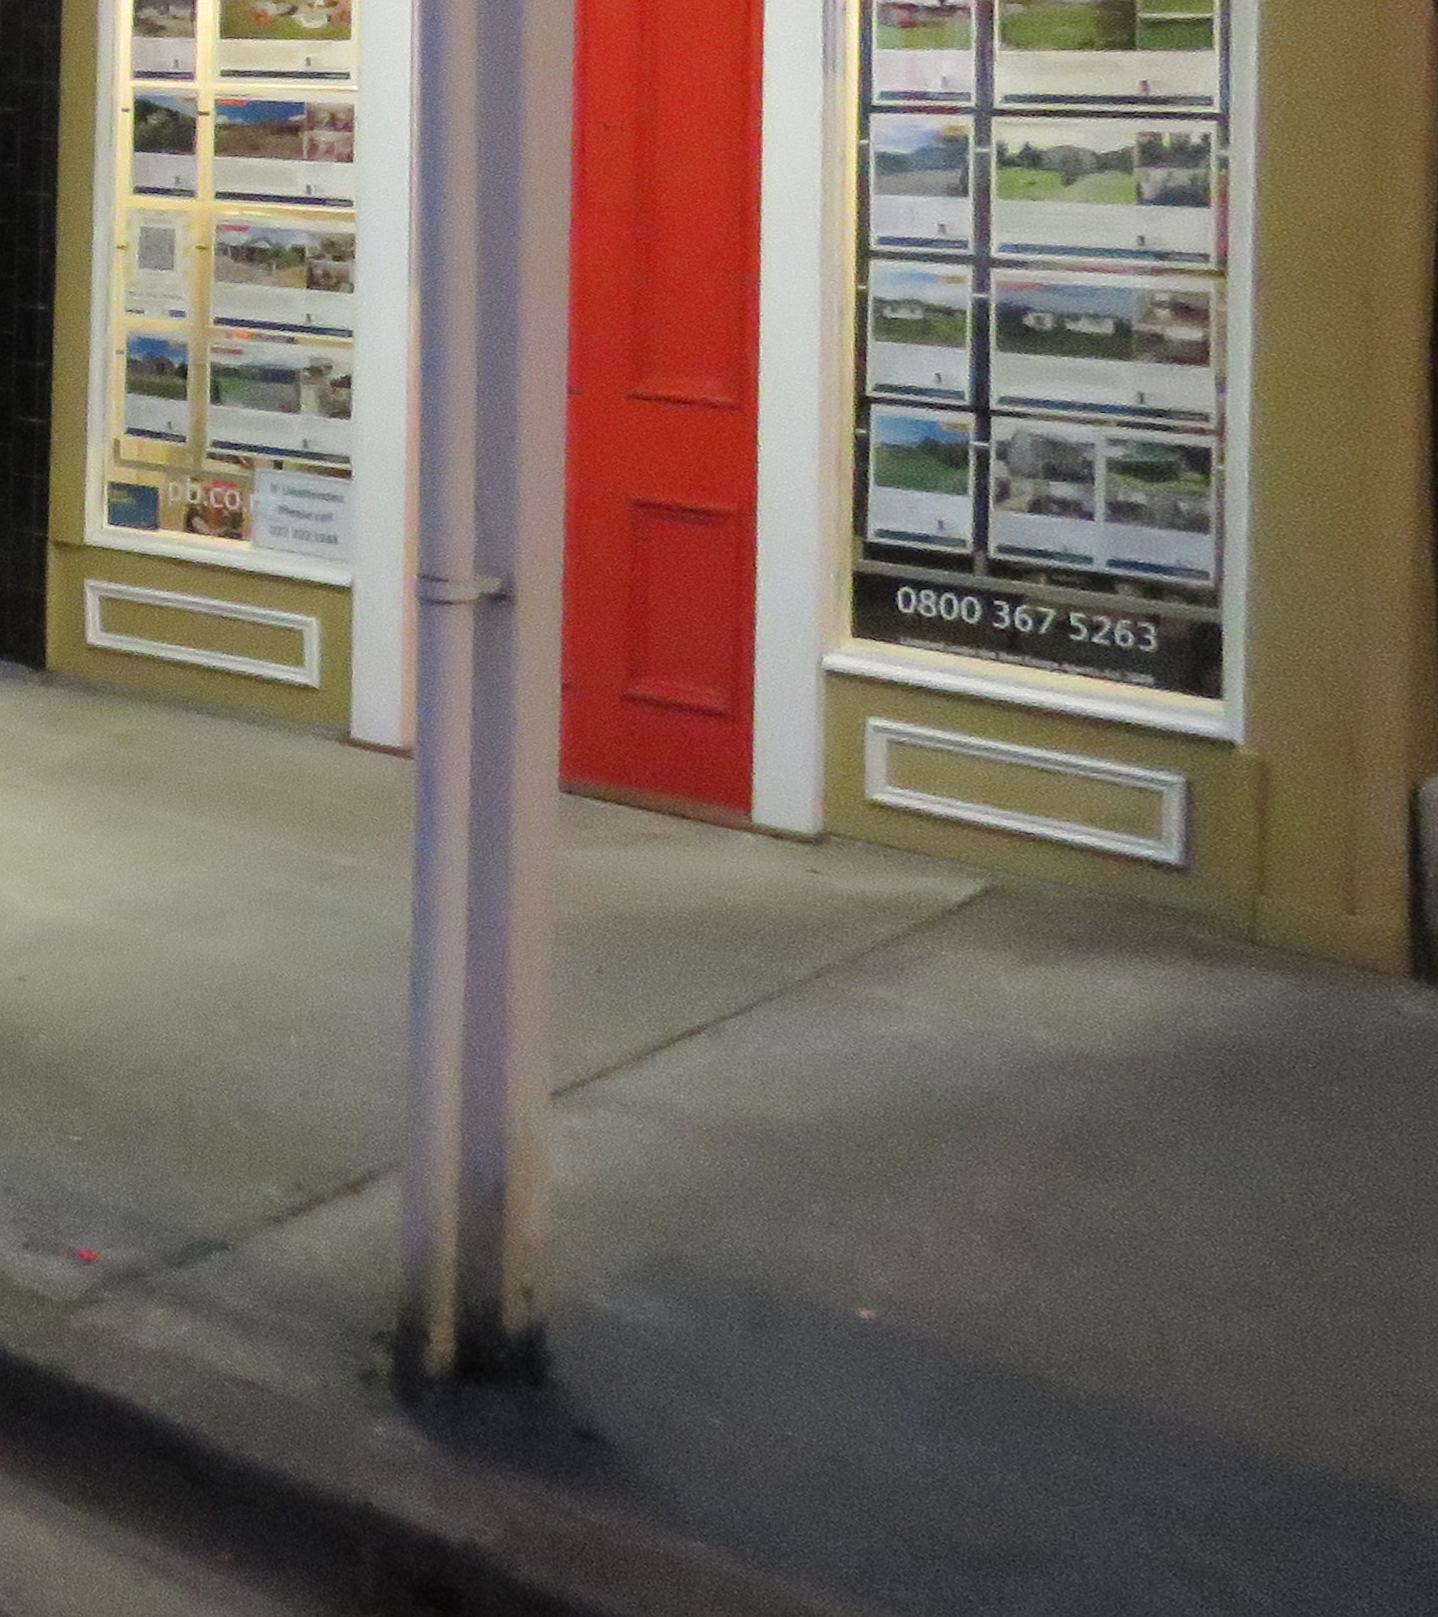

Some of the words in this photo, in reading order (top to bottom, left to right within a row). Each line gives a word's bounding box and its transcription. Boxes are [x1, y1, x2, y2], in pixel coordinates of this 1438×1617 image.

[895, 585, 982, 625] 0800
[992, 599, 1057, 636] 367
[1068, 612, 1159, 653] 5263
